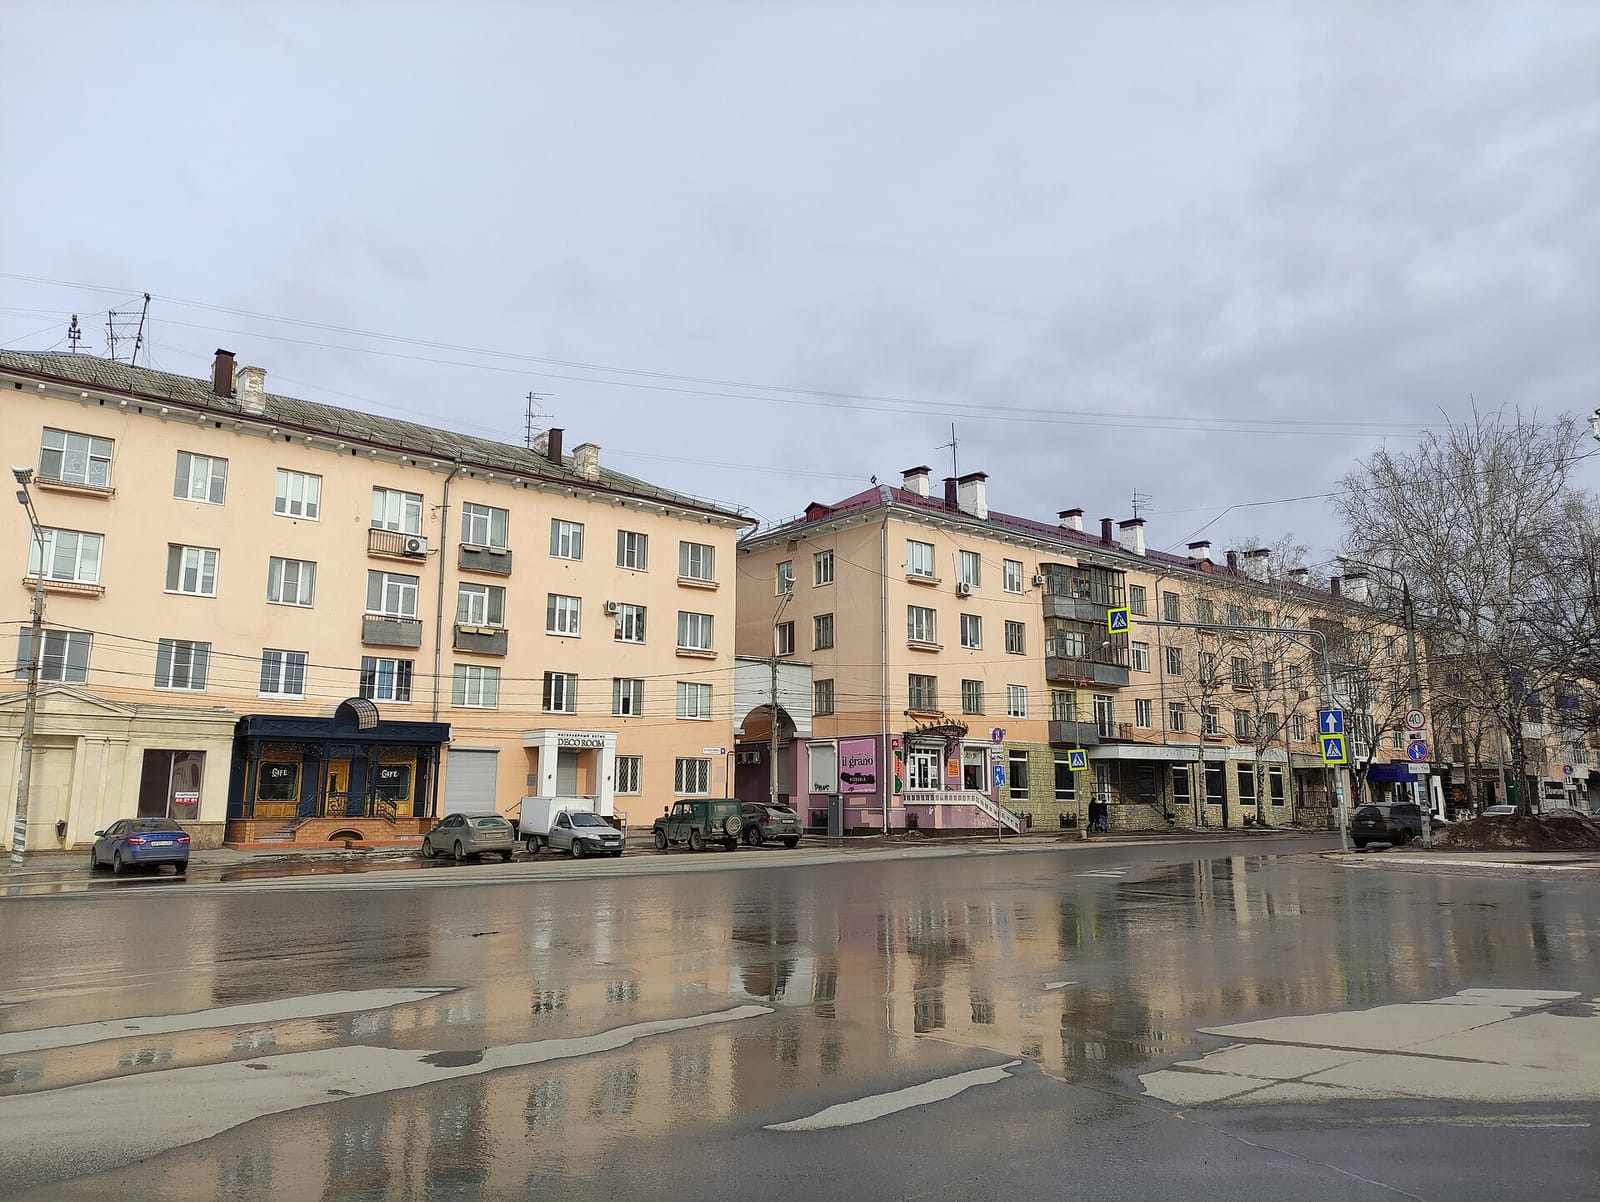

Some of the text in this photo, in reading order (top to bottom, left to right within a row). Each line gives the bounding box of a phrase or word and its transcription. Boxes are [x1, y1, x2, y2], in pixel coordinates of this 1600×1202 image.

[1408, 713, 1420, 725] 40
[557, 738, 605, 748] DECO ROOM
